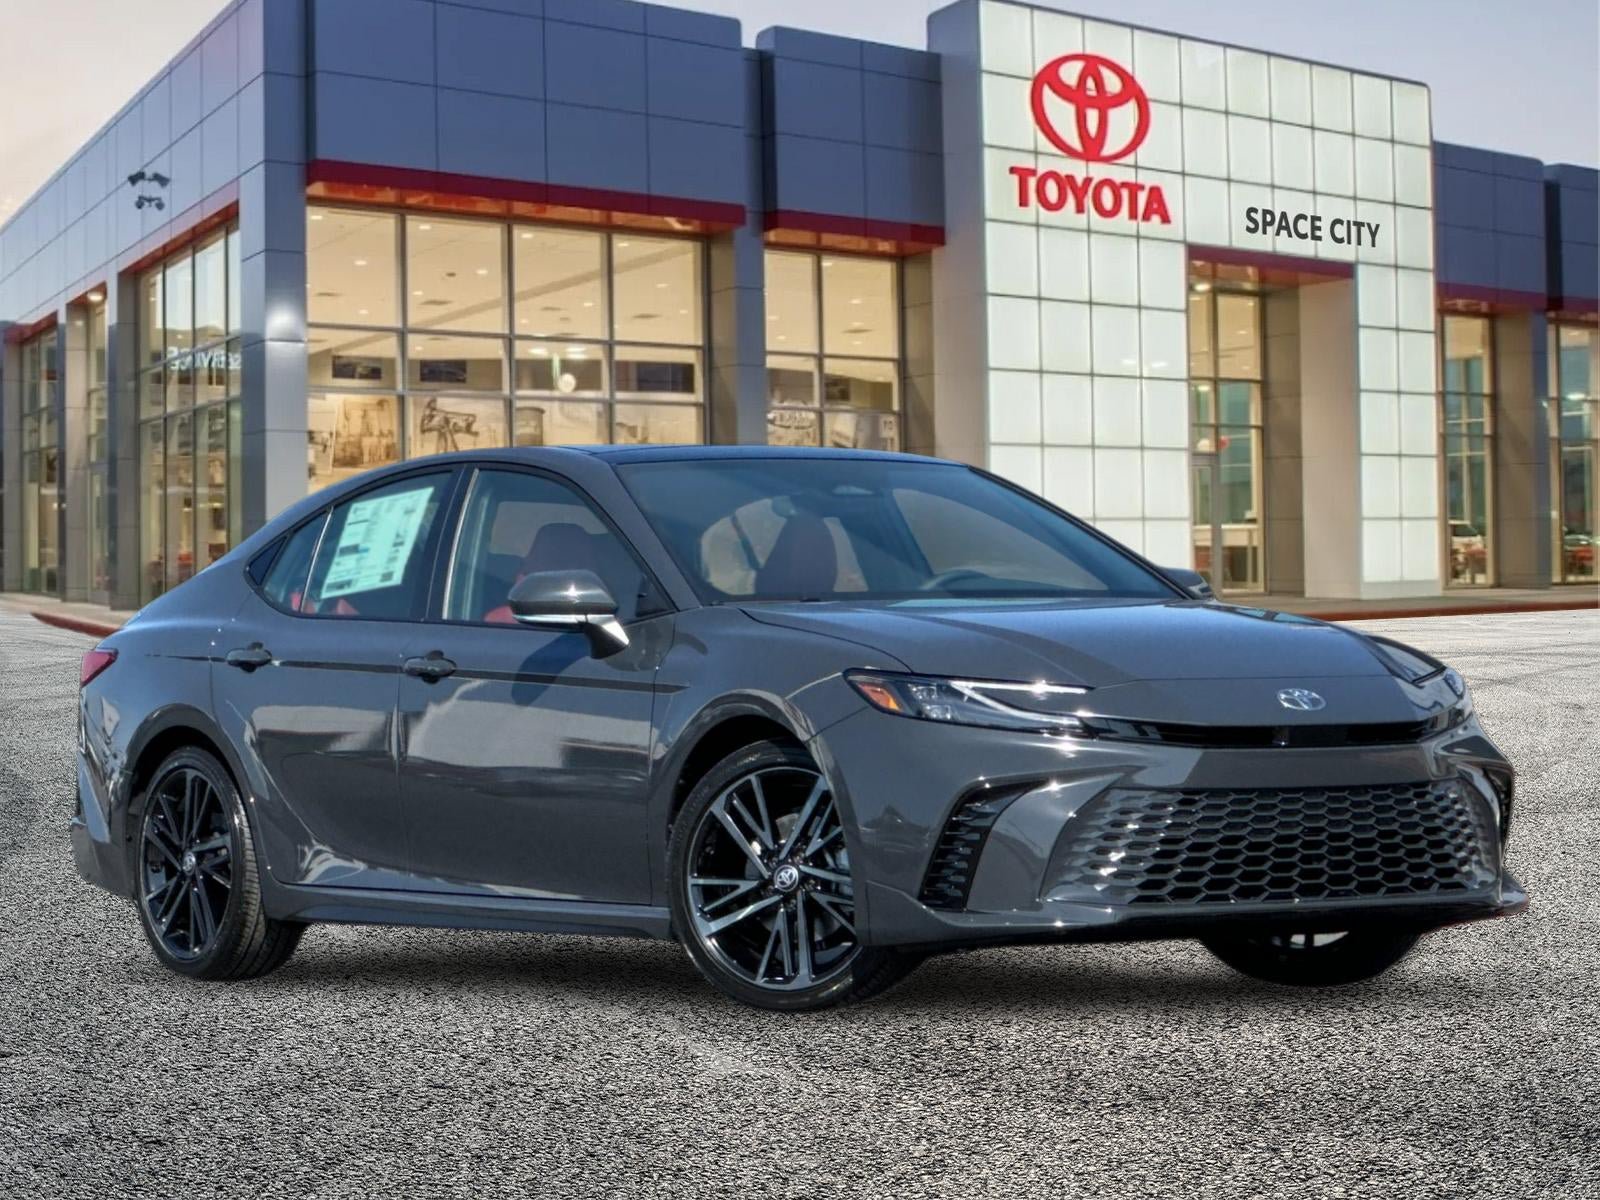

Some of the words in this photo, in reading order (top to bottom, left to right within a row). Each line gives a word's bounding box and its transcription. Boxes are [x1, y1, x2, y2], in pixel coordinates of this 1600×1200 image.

[1009, 166, 1171, 225] TOYOTA
[1245, 206, 1323, 242] SPACE
[1329, 218, 1380, 248] CITY
